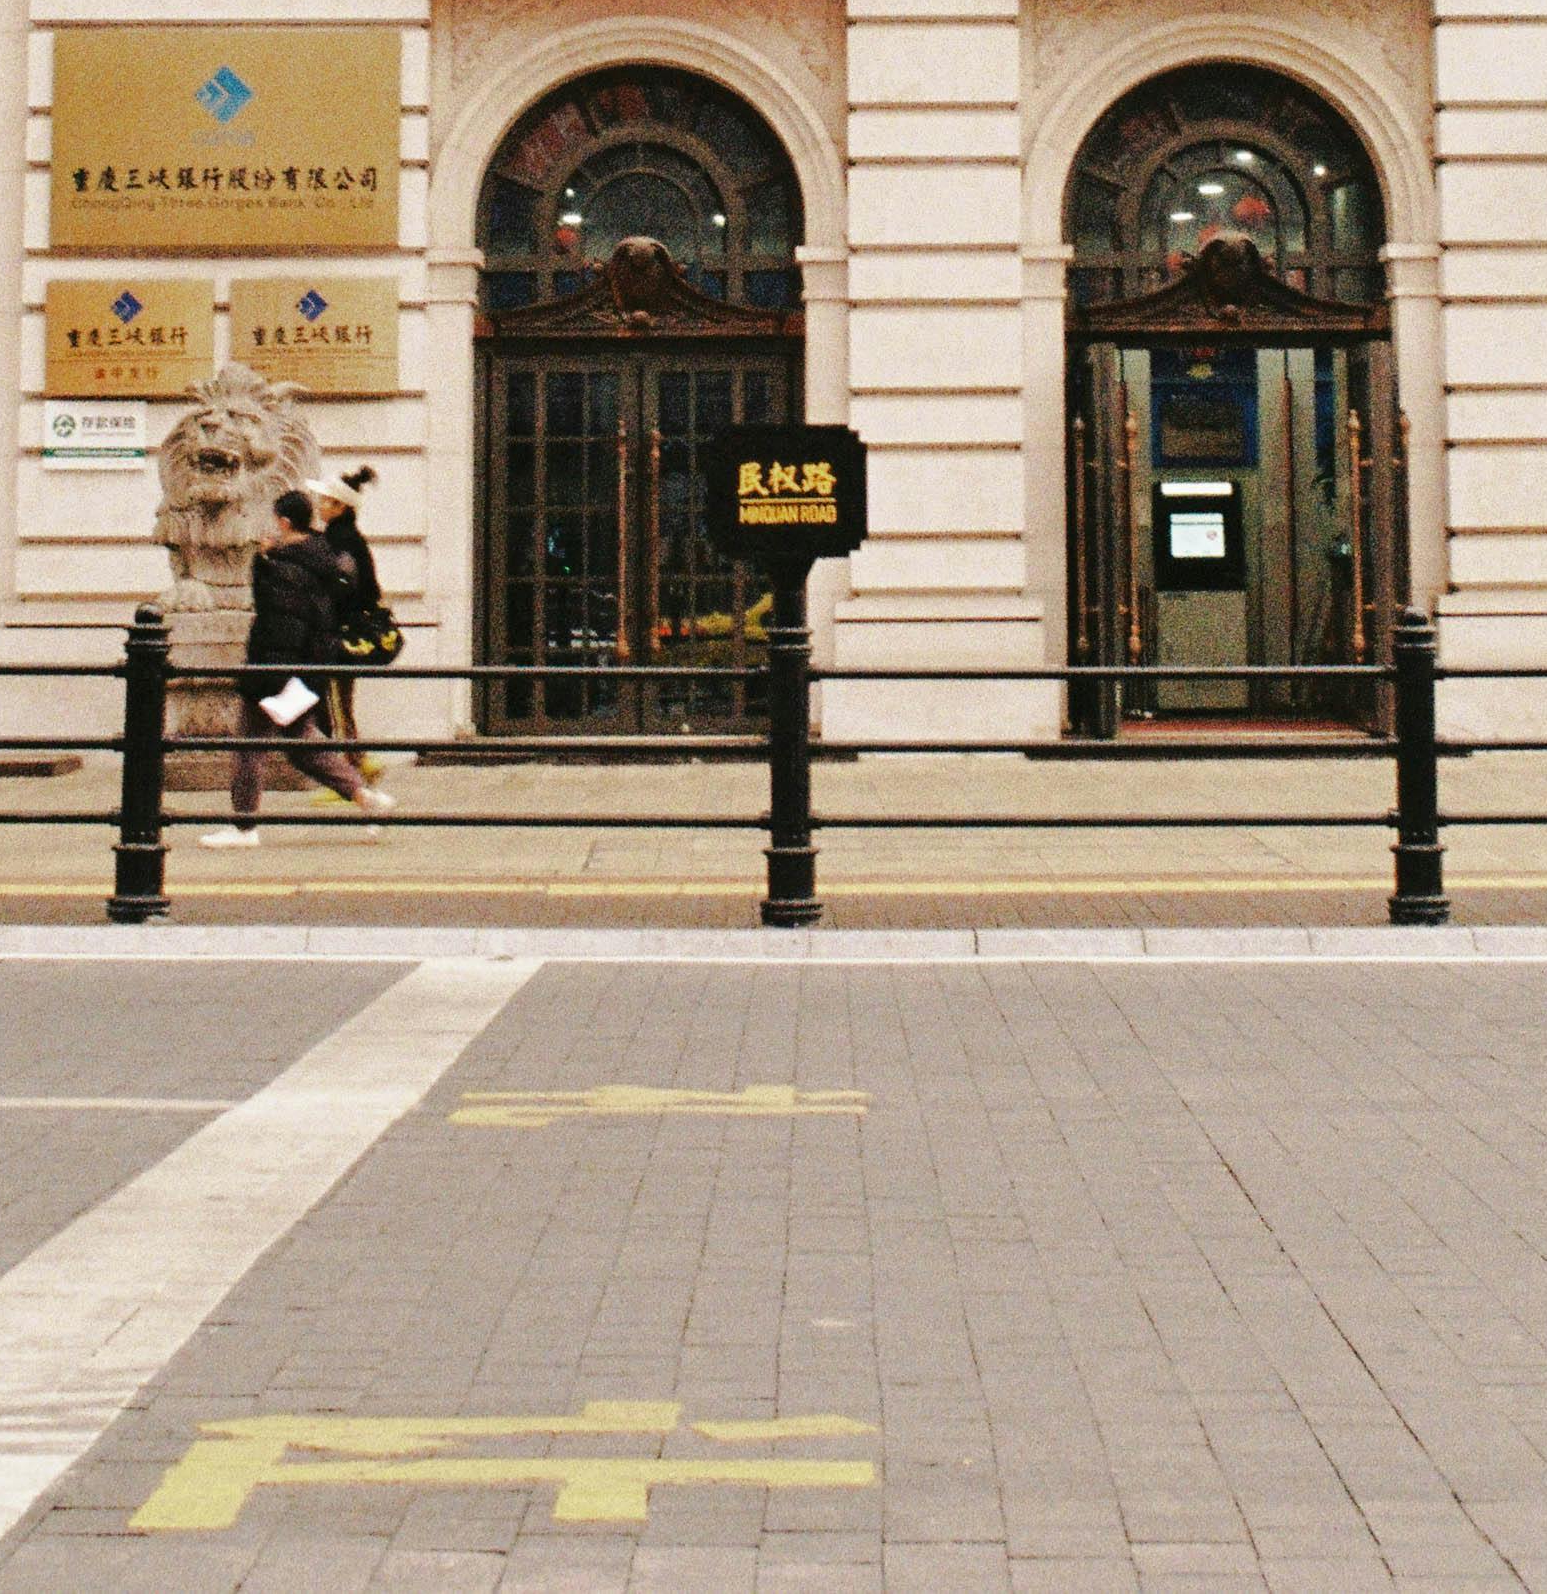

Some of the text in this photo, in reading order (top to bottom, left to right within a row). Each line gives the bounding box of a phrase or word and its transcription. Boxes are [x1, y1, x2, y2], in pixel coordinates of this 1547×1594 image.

[738, 461, 836, 495] 民权路
[739, 506, 837, 524] MINQUAN ROAD
